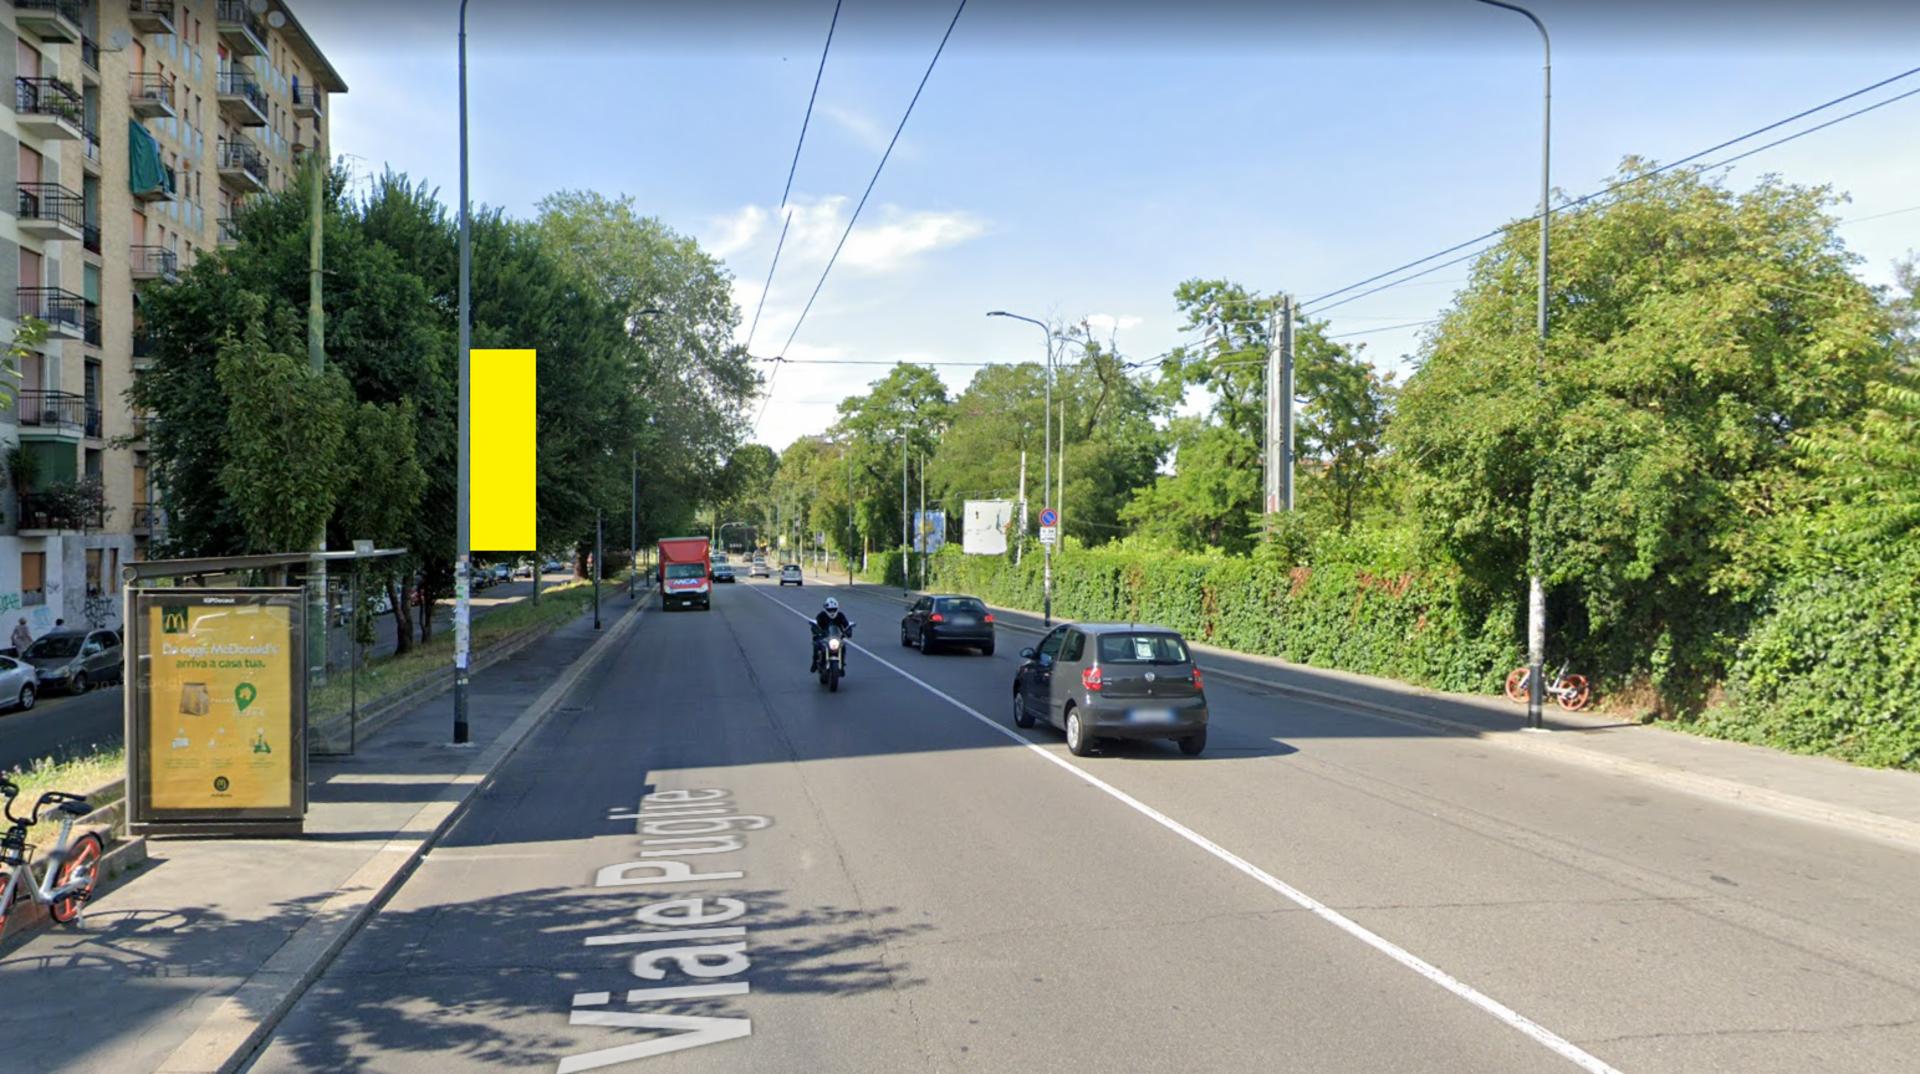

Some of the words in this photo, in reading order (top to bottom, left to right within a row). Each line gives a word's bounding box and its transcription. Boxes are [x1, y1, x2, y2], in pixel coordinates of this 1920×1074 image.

[211, 643, 280, 655] McDonald's
[176, 658, 208, 668] arriva
[209, 660, 216, 668] a
[218, 659, 242, 668] casa
